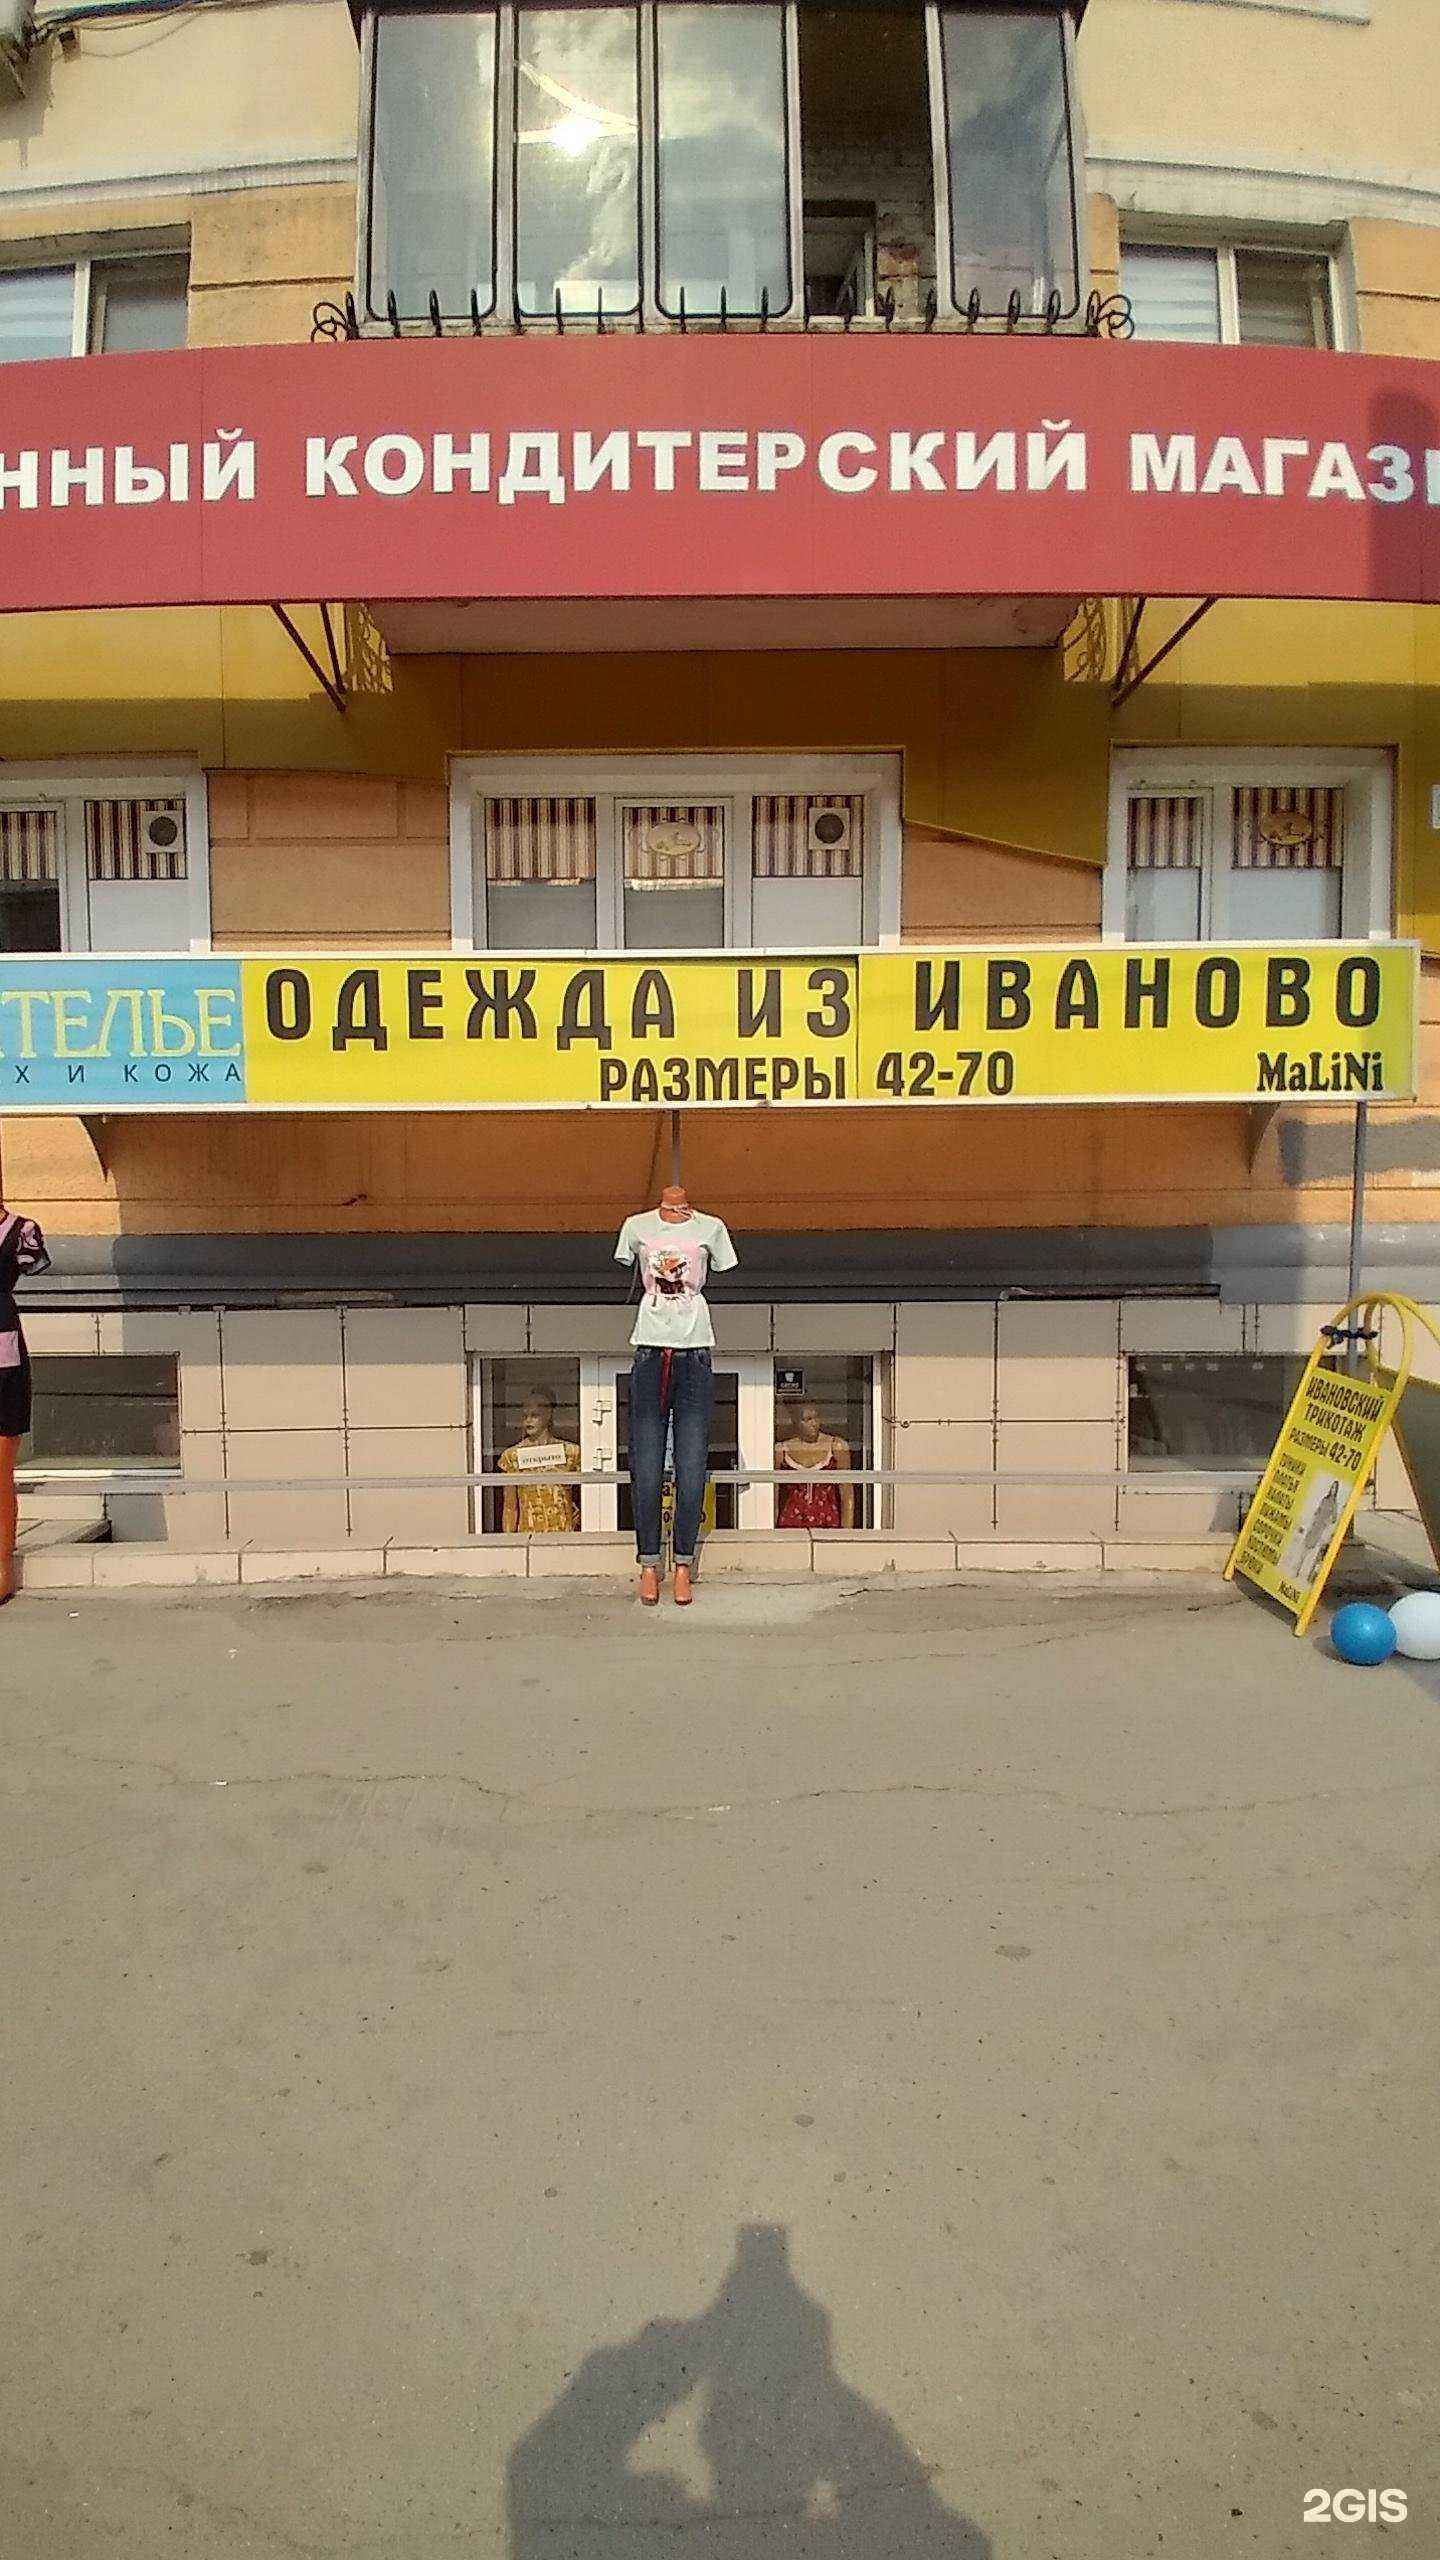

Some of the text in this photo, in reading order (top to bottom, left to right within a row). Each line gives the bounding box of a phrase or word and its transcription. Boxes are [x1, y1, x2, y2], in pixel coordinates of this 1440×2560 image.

[305, 418, 1089, 506] КОНДИТЕРСКИЙ
[0, 988, 242, 1059] ТЕЛЬЕ
[264, 955, 1382, 1052] ОДЕЖДА ИЗ ИВАНОВО
[67, 1064, 85, 1083] И
[123, 1063, 242, 1083] КОЖА
[600, 1051, 1015, 1102] РАЗМЕРЫ 42-70
[1256, 1050, 1385, 1094] MaLiNi
[1305, 1401, 1366, 1443] ТРИКОТАЖ
[1306, 1376, 1384, 1422] ИВАНОВСКИЙ
[1329, 1441, 1362, 1471] 42-70
